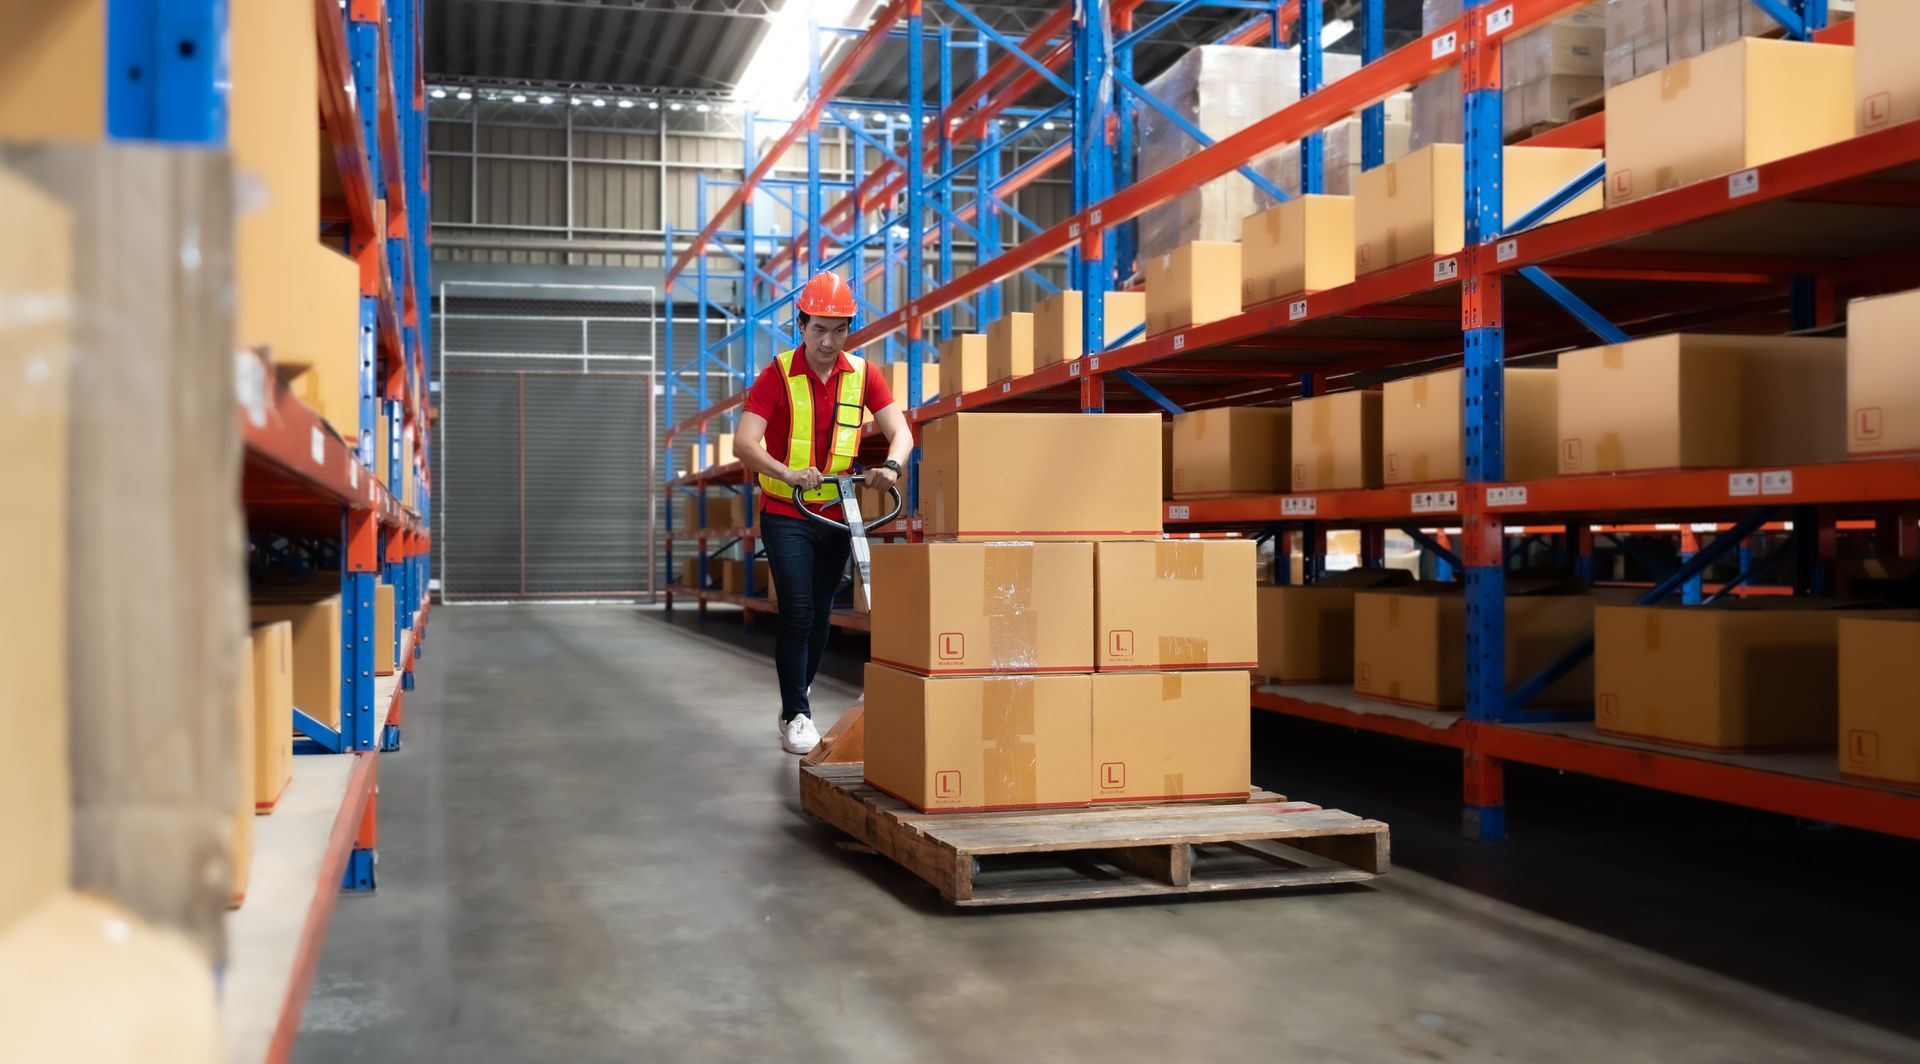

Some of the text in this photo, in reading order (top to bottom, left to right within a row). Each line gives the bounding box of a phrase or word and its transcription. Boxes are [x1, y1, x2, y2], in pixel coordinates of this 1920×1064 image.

[1871, 99, 1884, 120] L
[1617, 175, 1627, 192] L
[1862, 412, 1876, 434] L
[1568, 442, 1577, 460] L
[946, 637, 958, 655] L
[1108, 766, 1120, 784] L
